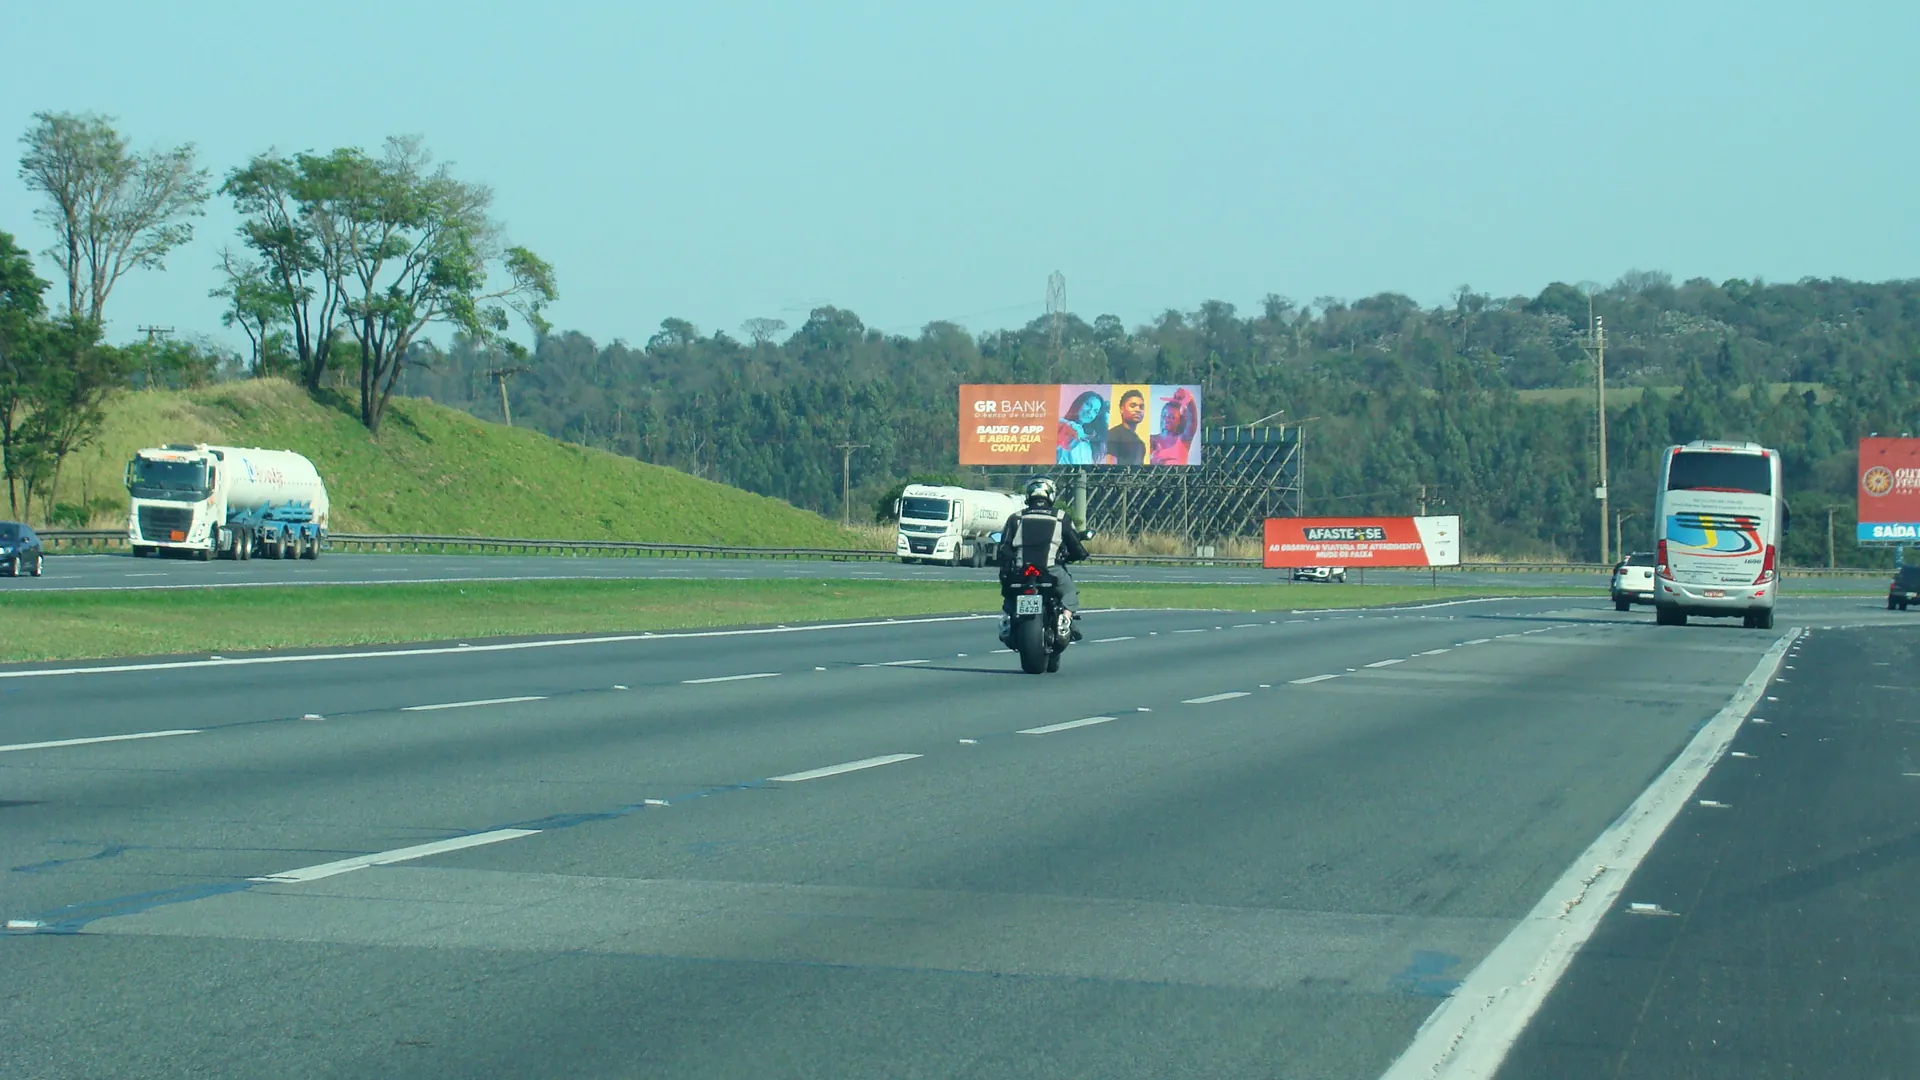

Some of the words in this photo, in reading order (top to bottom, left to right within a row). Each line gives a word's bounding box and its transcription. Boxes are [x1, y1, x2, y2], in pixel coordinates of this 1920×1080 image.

[974, 400, 997, 412] GR
[1001, 400, 1046, 412] BANK
[976, 425, 1009, 434] BAIXE
[1010, 425, 1019, 434] O
[1020, 425, 1044, 434] APP
[979, 434, 987, 443] E
[987, 434, 1017, 443] ABRA
[1020, 434, 1042, 443] SUA
[990, 443, 1031, 452] CONTA!
[1873, 523, 1916, 537] SAÍDA
